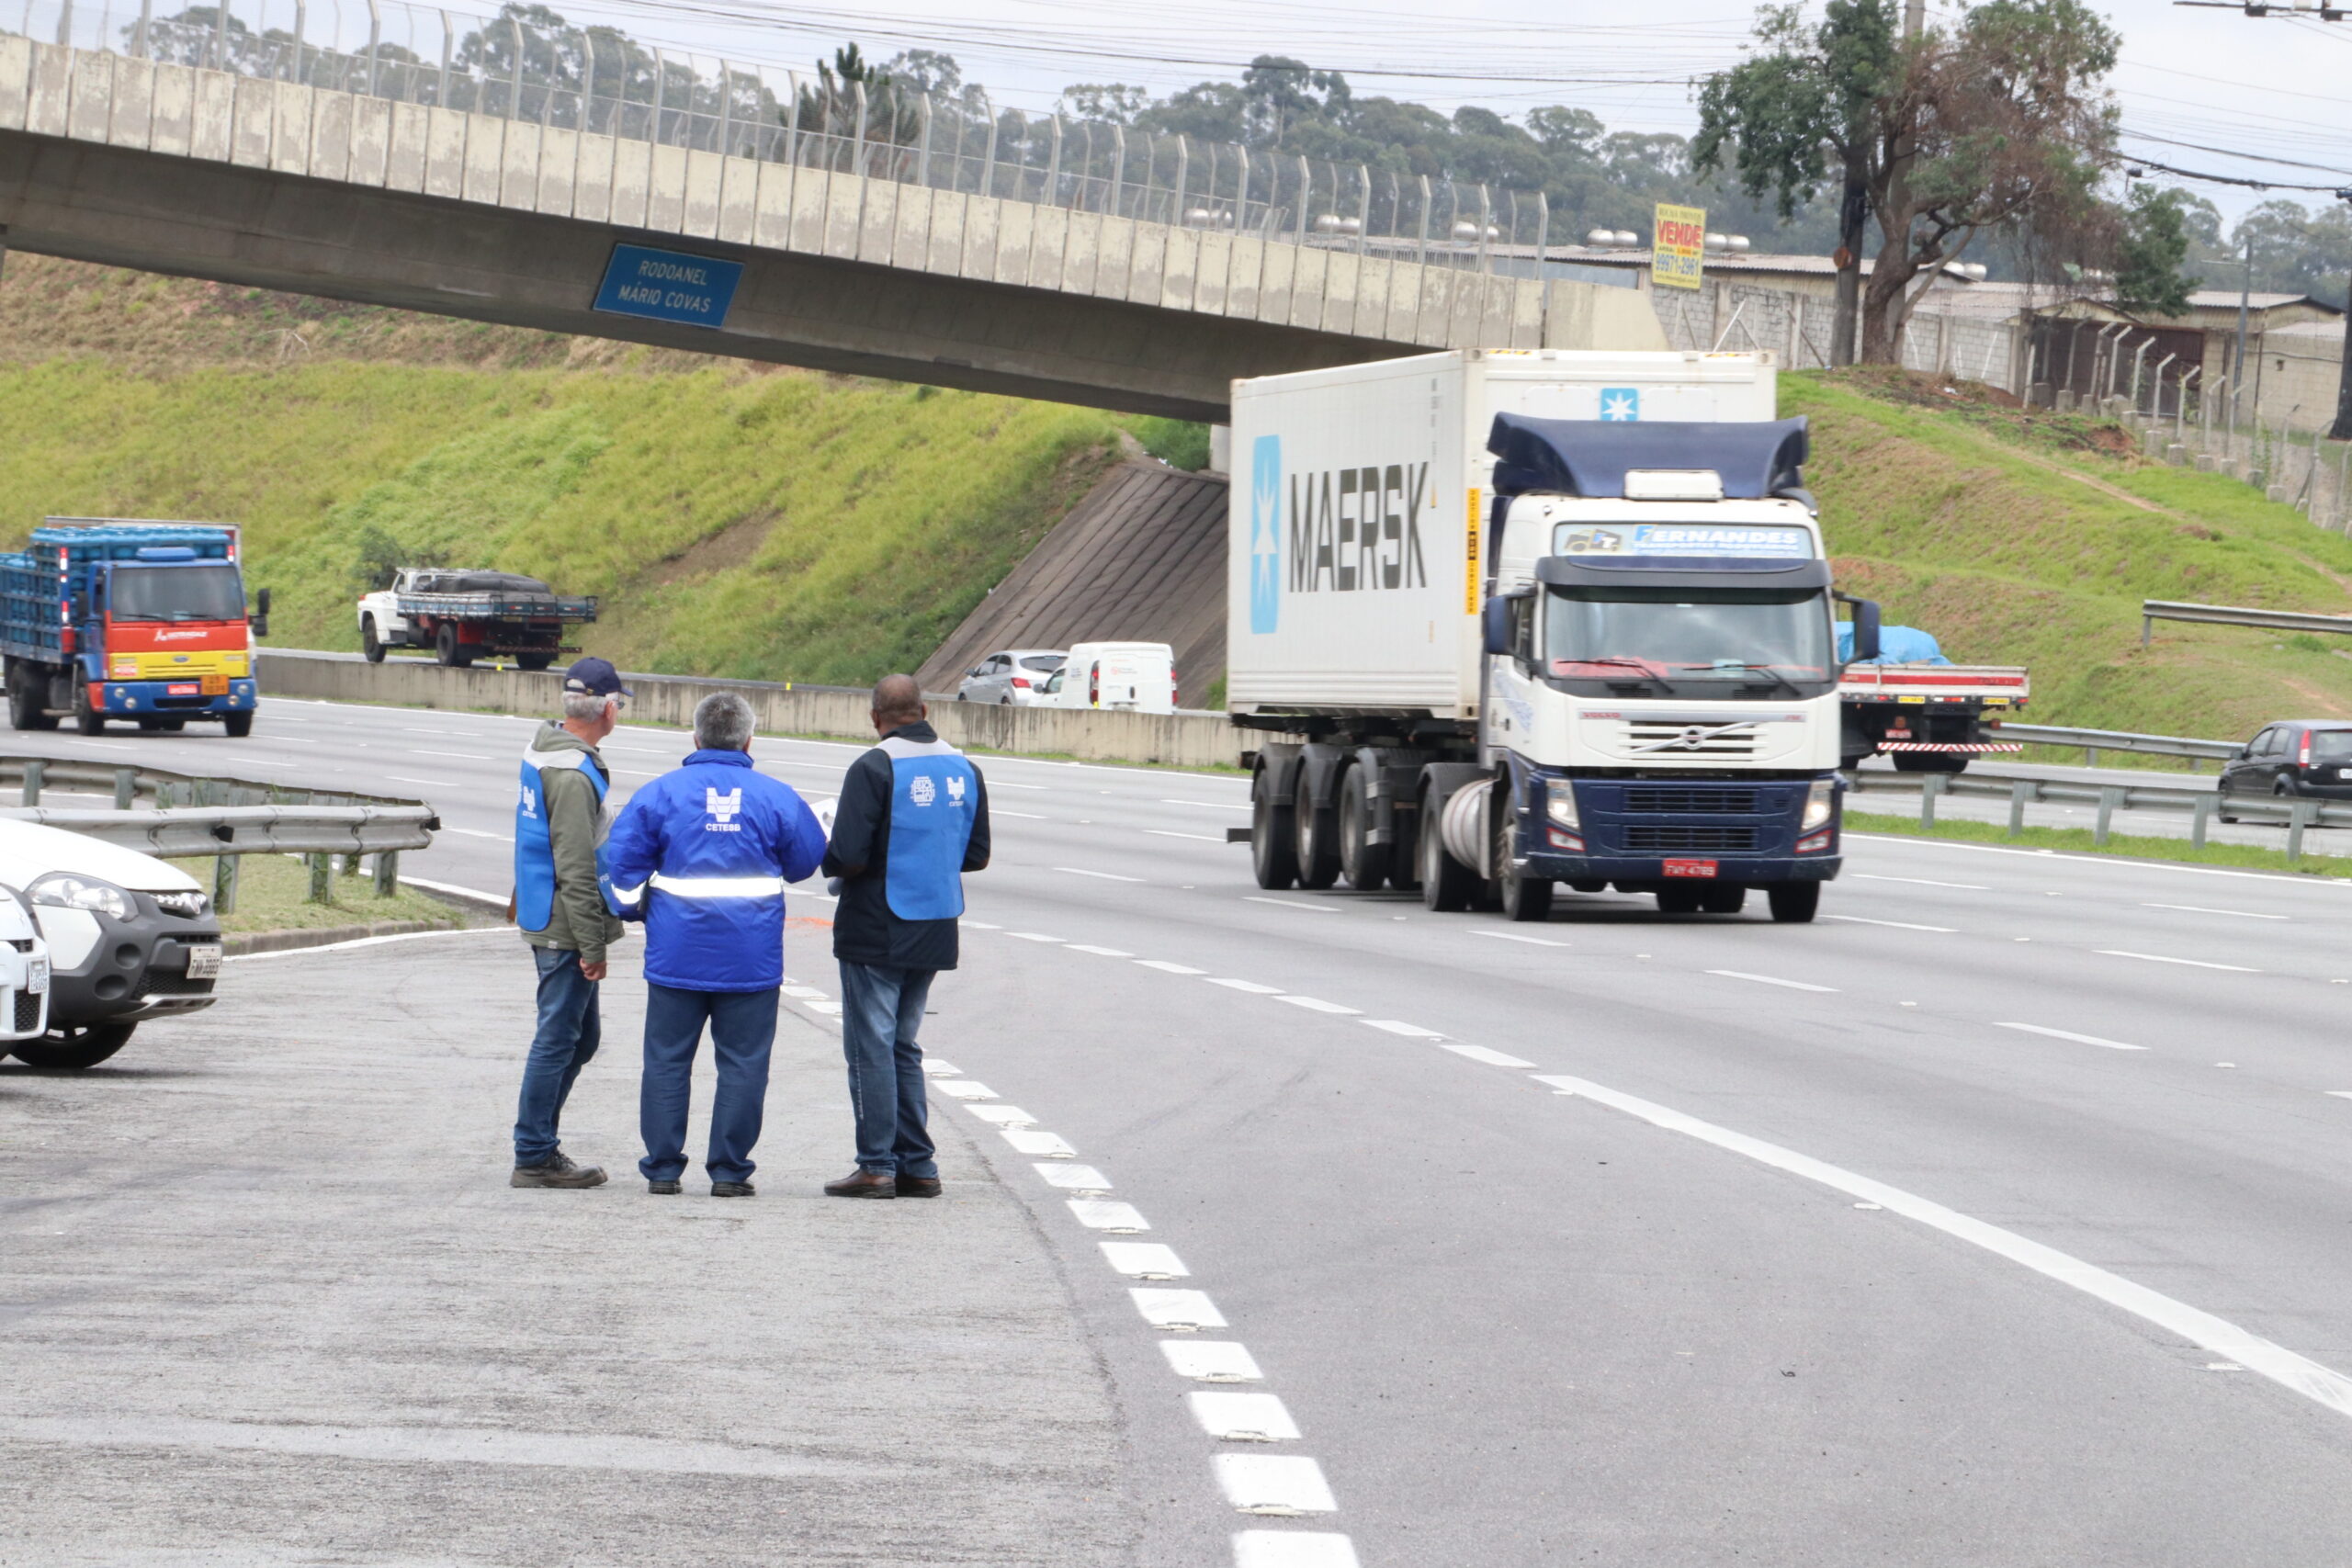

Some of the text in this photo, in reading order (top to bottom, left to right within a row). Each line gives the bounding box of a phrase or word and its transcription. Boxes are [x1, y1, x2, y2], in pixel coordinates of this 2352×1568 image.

[1657, 220, 1703, 248] VENDE
[638, 261, 707, 286] RODOANEL
[617, 281, 711, 312] MÁRIO COVAS
[1289, 461, 1429, 592] MAERSK
[1634, 525, 1798, 545] FERNANDES
[706, 823, 741, 832] CETESB
